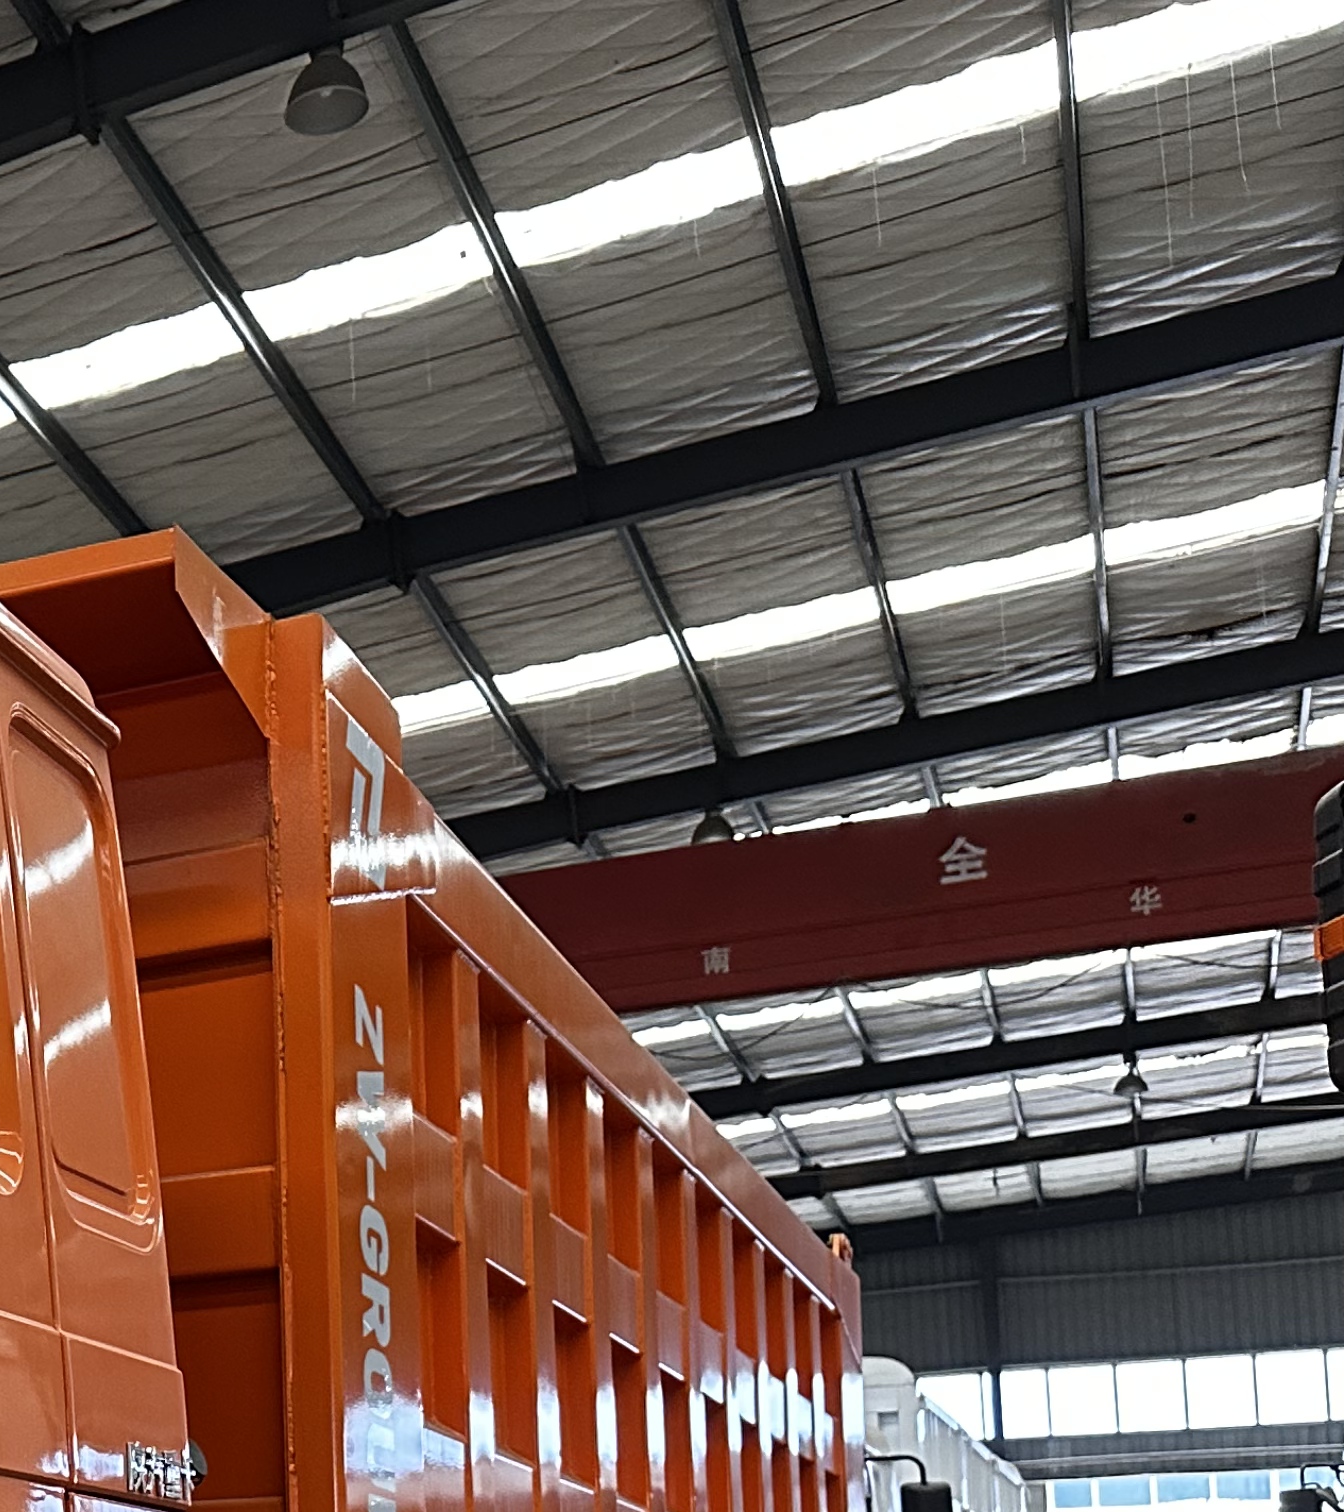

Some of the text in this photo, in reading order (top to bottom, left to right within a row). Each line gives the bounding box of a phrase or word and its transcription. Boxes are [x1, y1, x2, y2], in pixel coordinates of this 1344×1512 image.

[938, 836, 988, 885] 全
[701, 885, 1163, 975] 南 华
